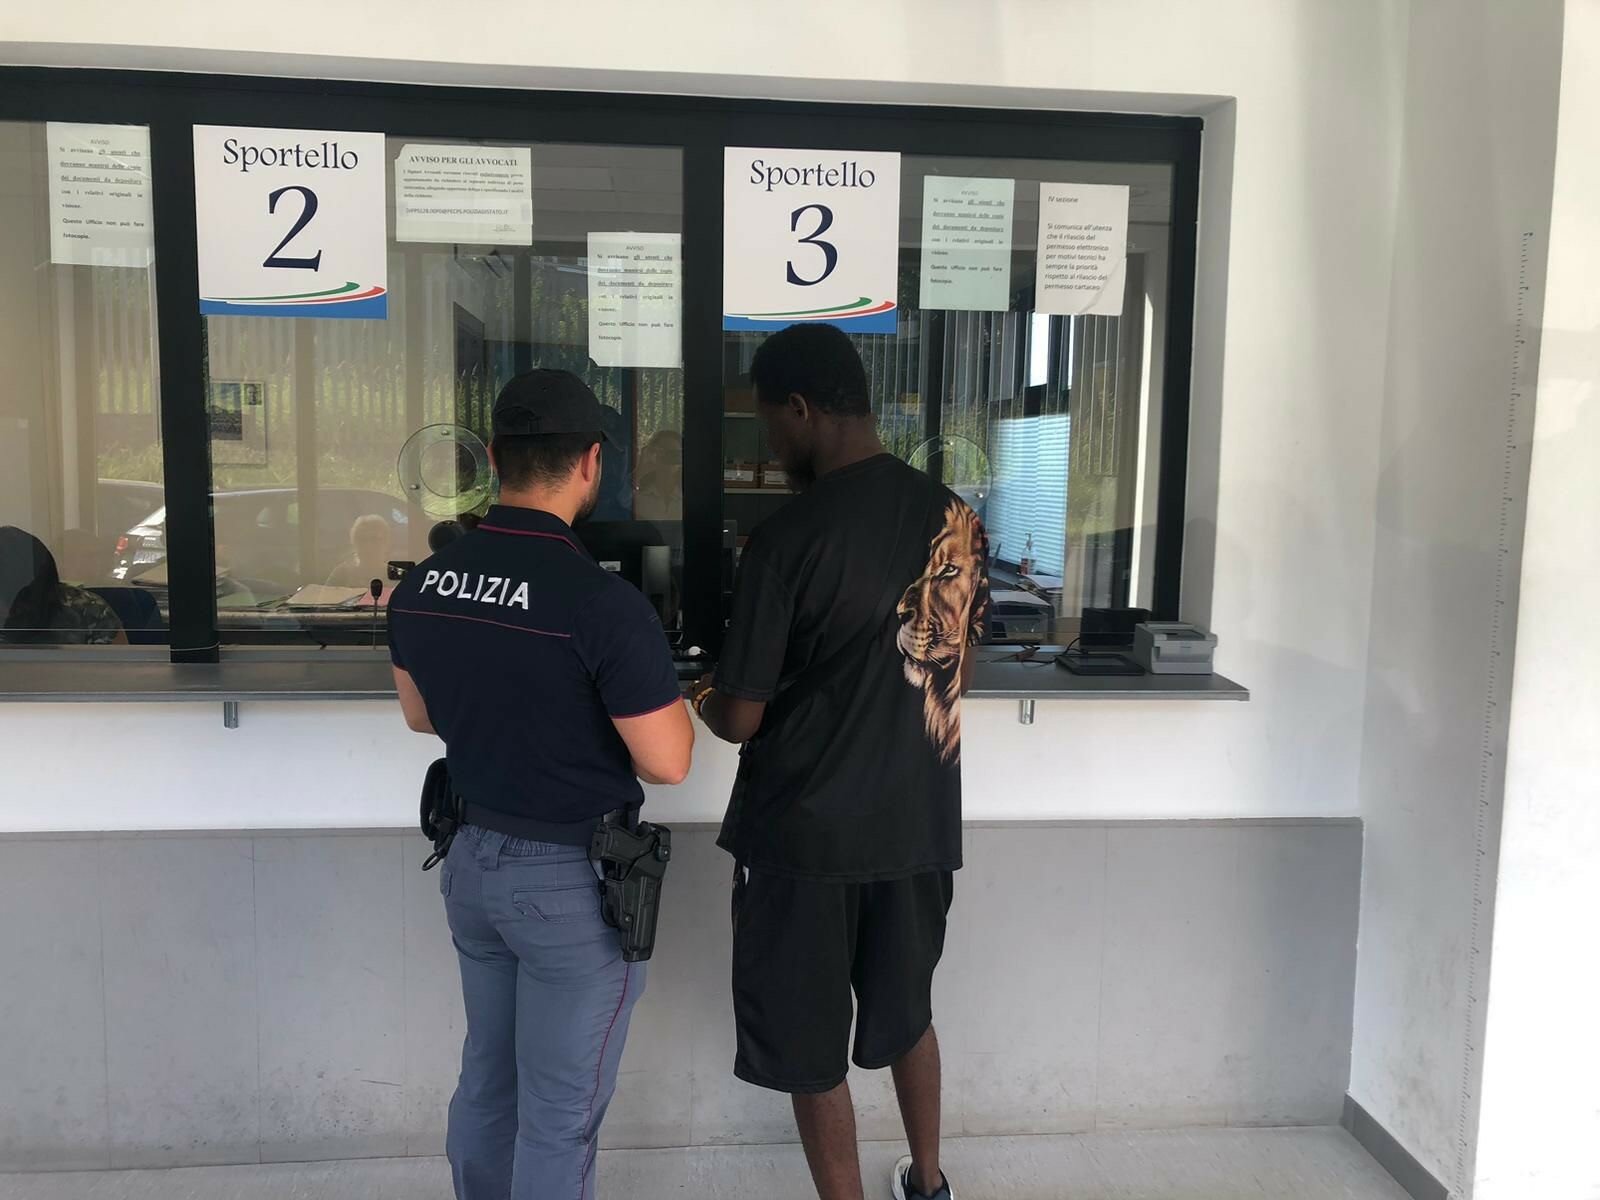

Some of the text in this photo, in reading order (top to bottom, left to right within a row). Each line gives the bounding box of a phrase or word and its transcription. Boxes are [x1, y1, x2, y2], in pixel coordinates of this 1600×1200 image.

[223, 139, 358, 172] Sportello
[459, 157, 474, 165] GLI
[474, 158, 517, 166] AVVOCATI
[751, 160, 875, 192] Sportello
[262, 185, 322, 272] 2
[786, 204, 837, 286] 3
[1077, 243, 1109, 251] elettronico
[419, 570, 529, 610] POLIZIA
